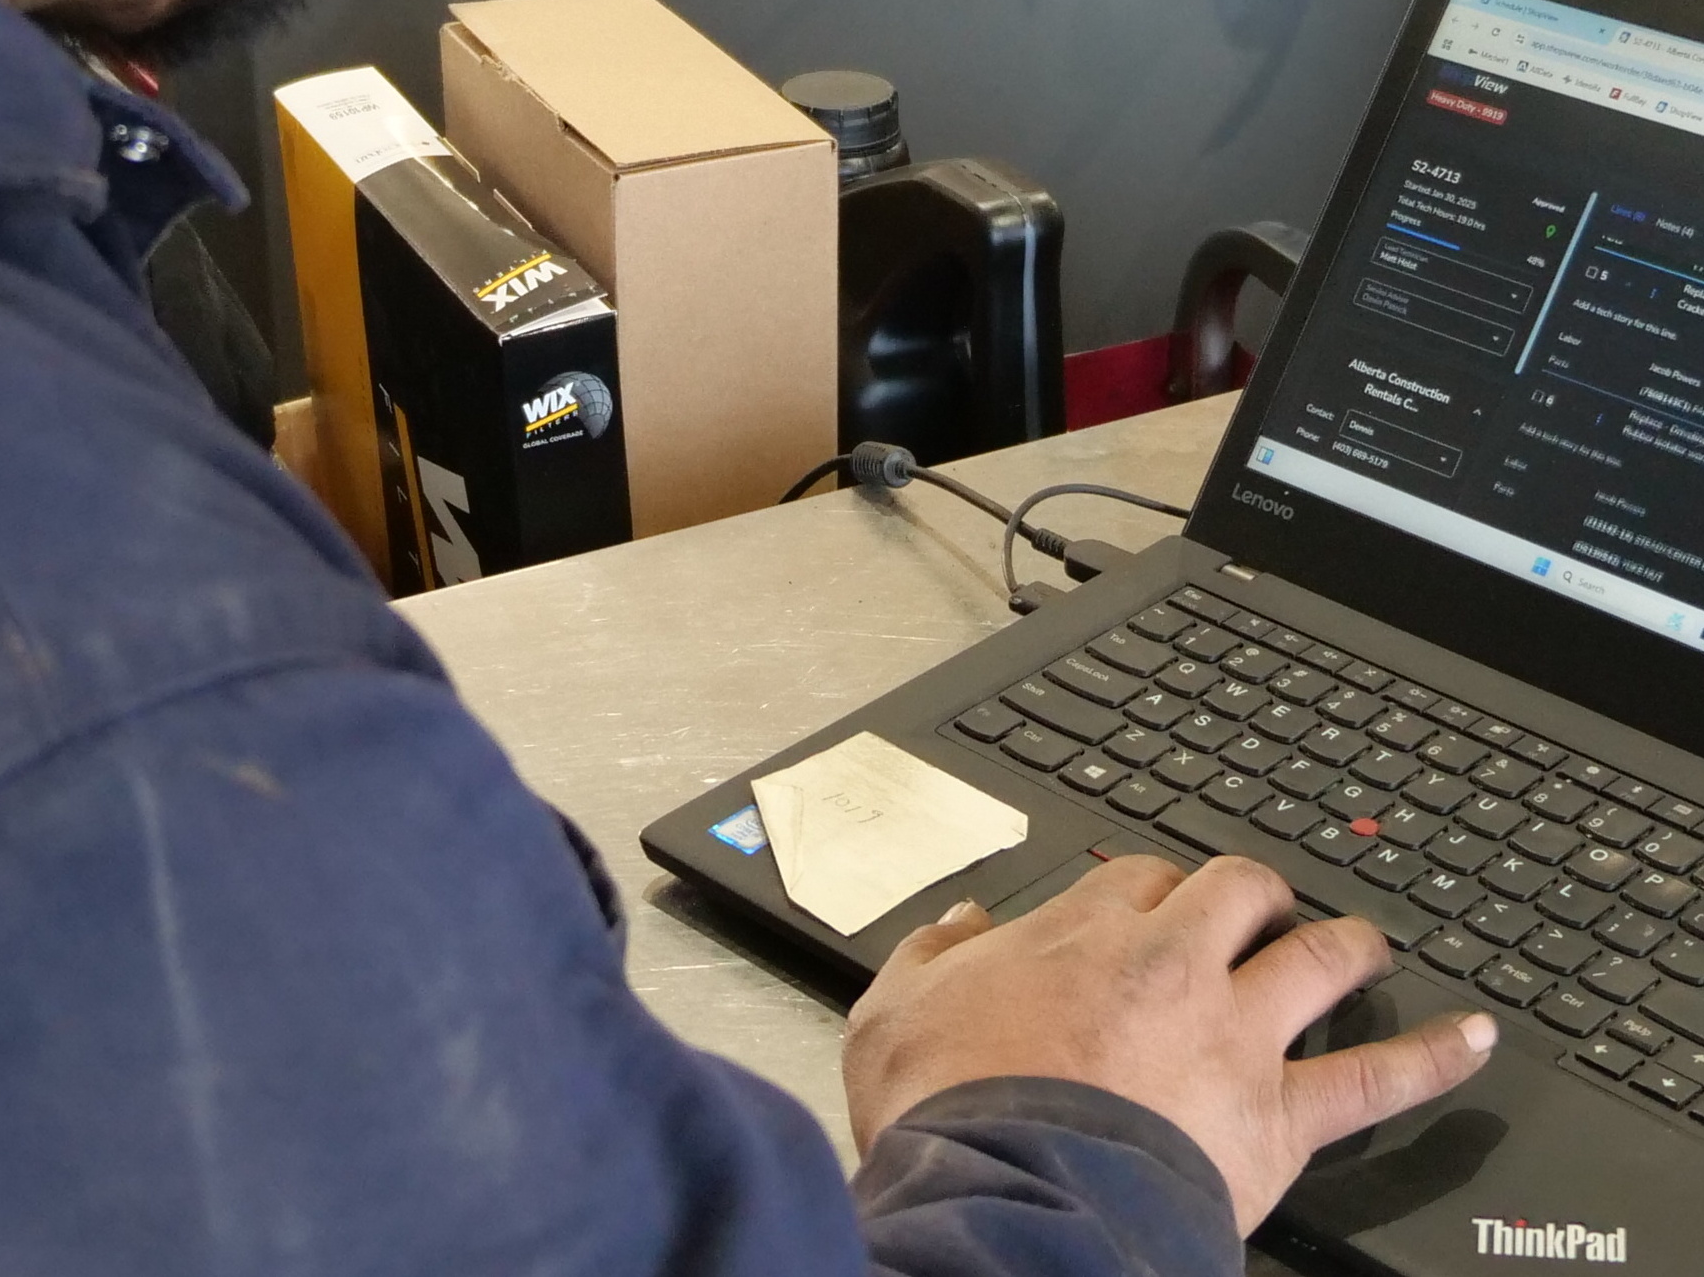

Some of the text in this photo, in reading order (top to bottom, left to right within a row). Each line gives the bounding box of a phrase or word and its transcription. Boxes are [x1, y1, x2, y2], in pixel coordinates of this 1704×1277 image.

[1430, 92, 1455, 106] Heavy
[1455, 99, 1476, 113] Duty
[1411, 159, 1461, 184] S2-4713
[1431, 189, 1444, 199] Jan
[1531, 197, 1565, 213] Approved
[1390, 209, 1421, 227] Progress
[1397, 195, 1415, 207] Total
[1416, 201, 1432, 213] Tech
[1473, 220, 1486, 230] hrs
[1655, 218, 1681, 233] Notes
[1599, 270, 1608, 280] 5
[479, 261, 568, 312] WIX
[1572, 298, 1590, 310] Add
[1595, 306, 1613, 318] tech
[1612, 313, 1633, 326] story
[1632, 318, 1648, 330] for
[1644, 323, 1660, 334] this
[1558, 332, 1581, 345] Labor
[1348, 358, 1450, 403] Alberta Construction
[1649, 362, 1701, 387] Jacob Powers
[1364, 383, 1402, 405] Rentals
[522, 381, 577, 423] WIX
[1305, 403, 1334, 420] Contact:
[1296, 426, 1320, 441] Phone:
[1348, 420, 1374, 435] Dennis
[522, 429, 584, 449] GLOBAL COVERAGE
[1231, 482, 1295, 521] Lenovo
[1577, 577, 1605, 594] Search
[1109, 633, 1125, 645] Tab
[1229, 656, 1244, 667] 2
[1066, 658, 1109, 682] CapsLock
[1179, 662, 1196, 675] Q
[1022, 682, 1045, 697] Shift
[1276, 678, 1291, 688] 3
[1226, 683, 1248, 697] W
[1146, 693, 1163, 705] A
[1327, 701, 1341, 710] 4
[1272, 704, 1291, 718] E
[1194, 715, 1211, 726] S
[1321, 728, 1340, 740] R
[1376, 723, 1391, 733] 5
[1023, 730, 1044, 743] Ctrl
[1125, 729, 1145, 741] Z
[1241, 737, 1260, 749] D
[1376, 750, 1392, 762] T
[1427, 745, 1442, 756] 6
[1174, 753, 1194, 764] X
[1291, 760, 1310, 771] F
[1428, 774, 1445, 785] Y
[1480, 769, 1495, 778] 7
[1129, 782, 1146, 794] Alt
[1225, 777, 1243, 788] C
[1344, 785, 1362, 798] G
[1533, 793, 1548, 803] 8
[1276, 799, 1295, 812] V
[1479, 798, 1497, 810] U
[1395, 808, 1415, 822] H
[1589, 817, 1604, 828] 9
[1321, 827, 1340, 839] B
[1449, 834, 1466, 844] J
[1378, 848, 1399, 862] N
[1589, 848, 1608, 861] O
[1502, 858, 1524, 872] K
[1432, 874, 1456, 890] M
[1644, 874, 1664, 884] P
[1559, 884, 1573, 897] L
[1444, 936, 1463, 949] Alt
[1501, 963, 1533, 984] PrtSc
[1560, 992, 1586, 1009] Ctrl
[1623, 1019, 1652, 1037] PgUp
[1471, 1217, 1627, 1263] ThinkPad
